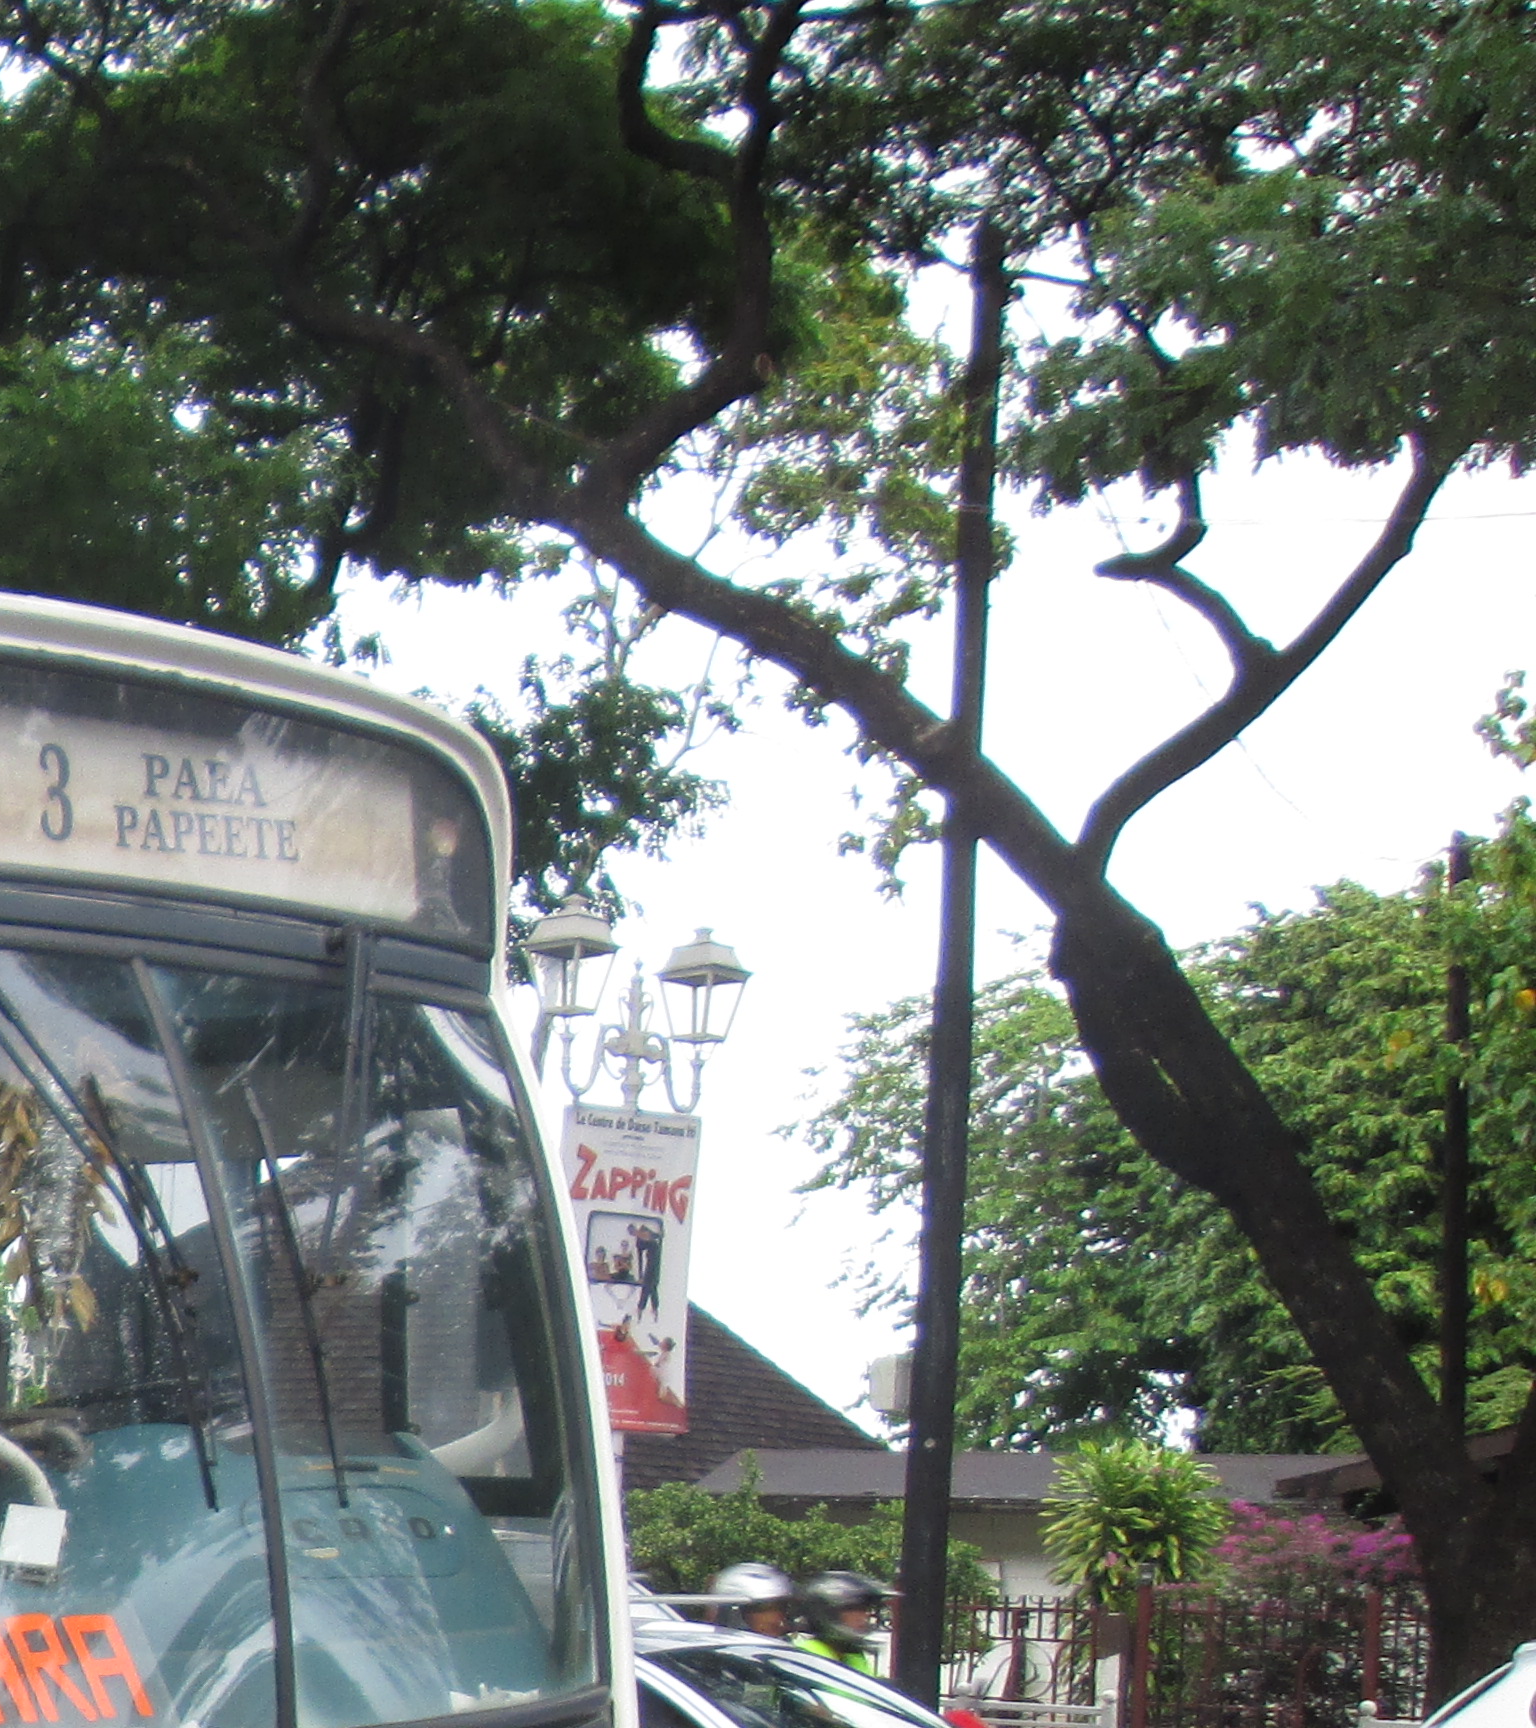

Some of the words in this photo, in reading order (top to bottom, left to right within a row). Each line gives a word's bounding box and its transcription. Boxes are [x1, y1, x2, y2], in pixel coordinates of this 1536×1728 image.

[38, 743, 74, 842] 3
[141, 753, 269, 808] PAEA
[113, 804, 301, 862] PAPEETE
[292, 1515, 437, 1543] CAO
